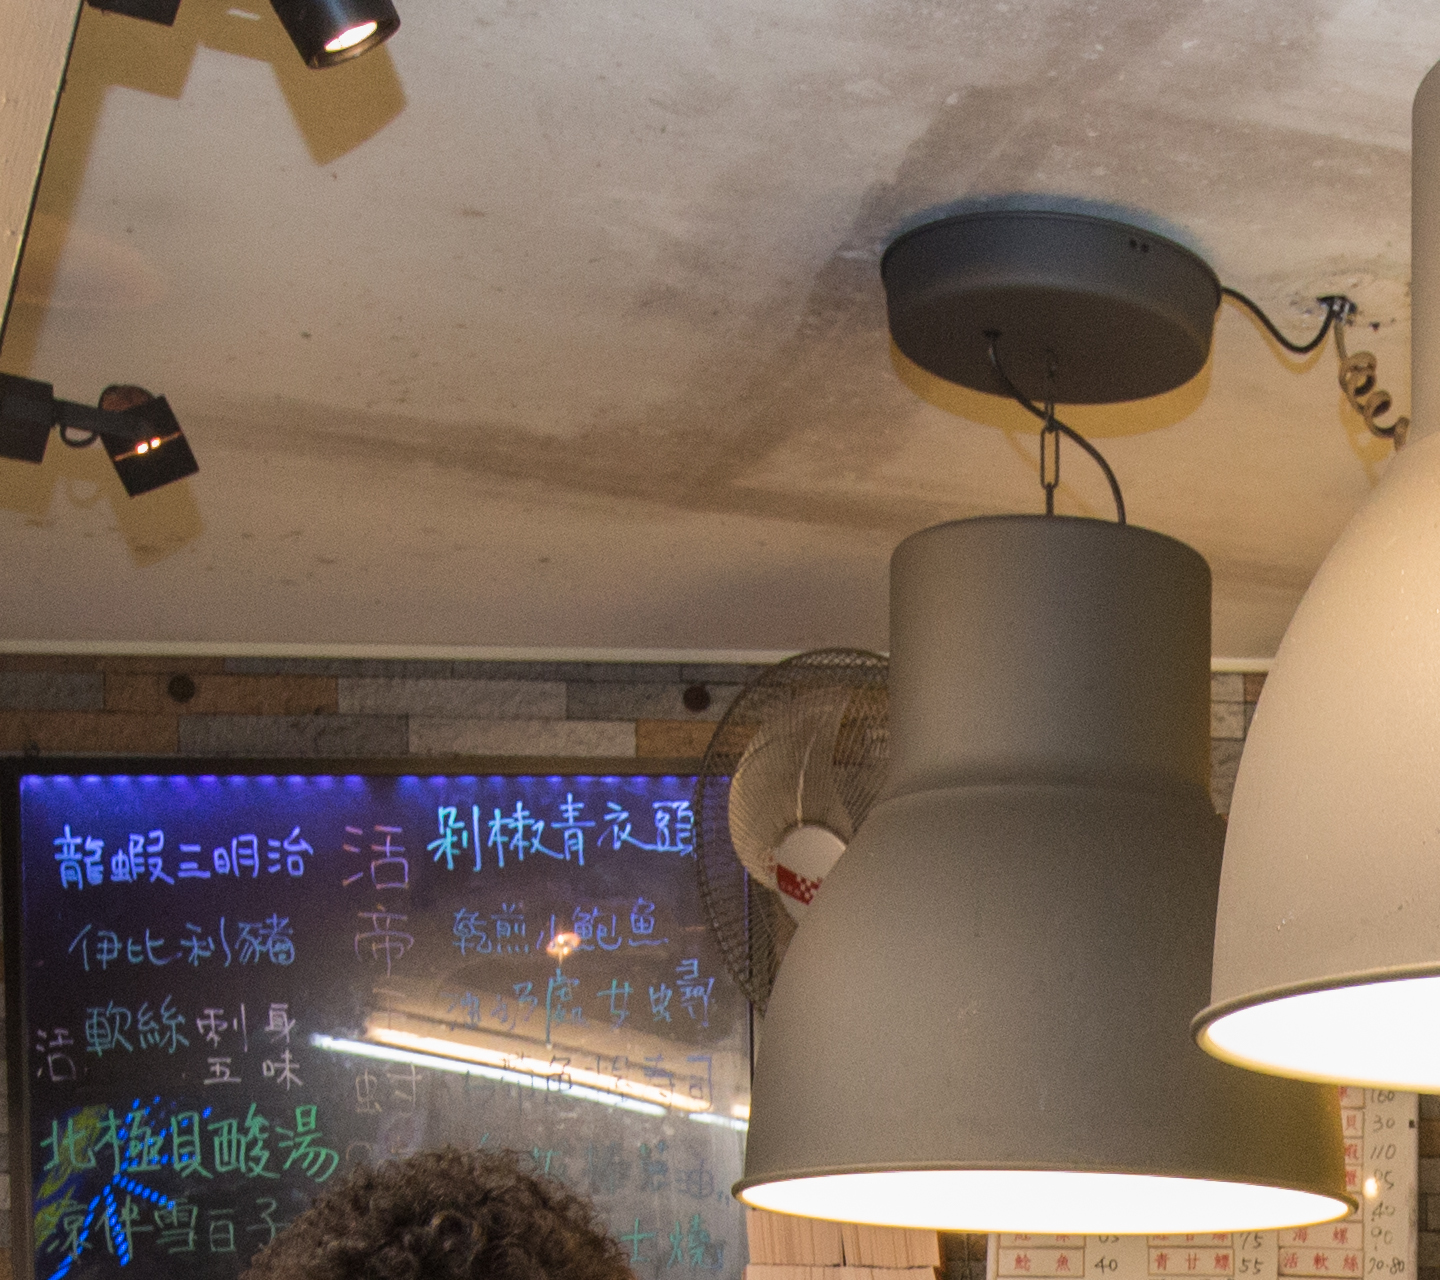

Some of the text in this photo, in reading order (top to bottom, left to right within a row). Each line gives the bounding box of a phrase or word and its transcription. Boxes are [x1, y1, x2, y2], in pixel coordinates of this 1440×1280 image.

[53, 823, 315, 890] 龍蝦三明治
[67, 913, 296, 972] 伊比利豬
[1093, 1255, 1120, 1275] 40
